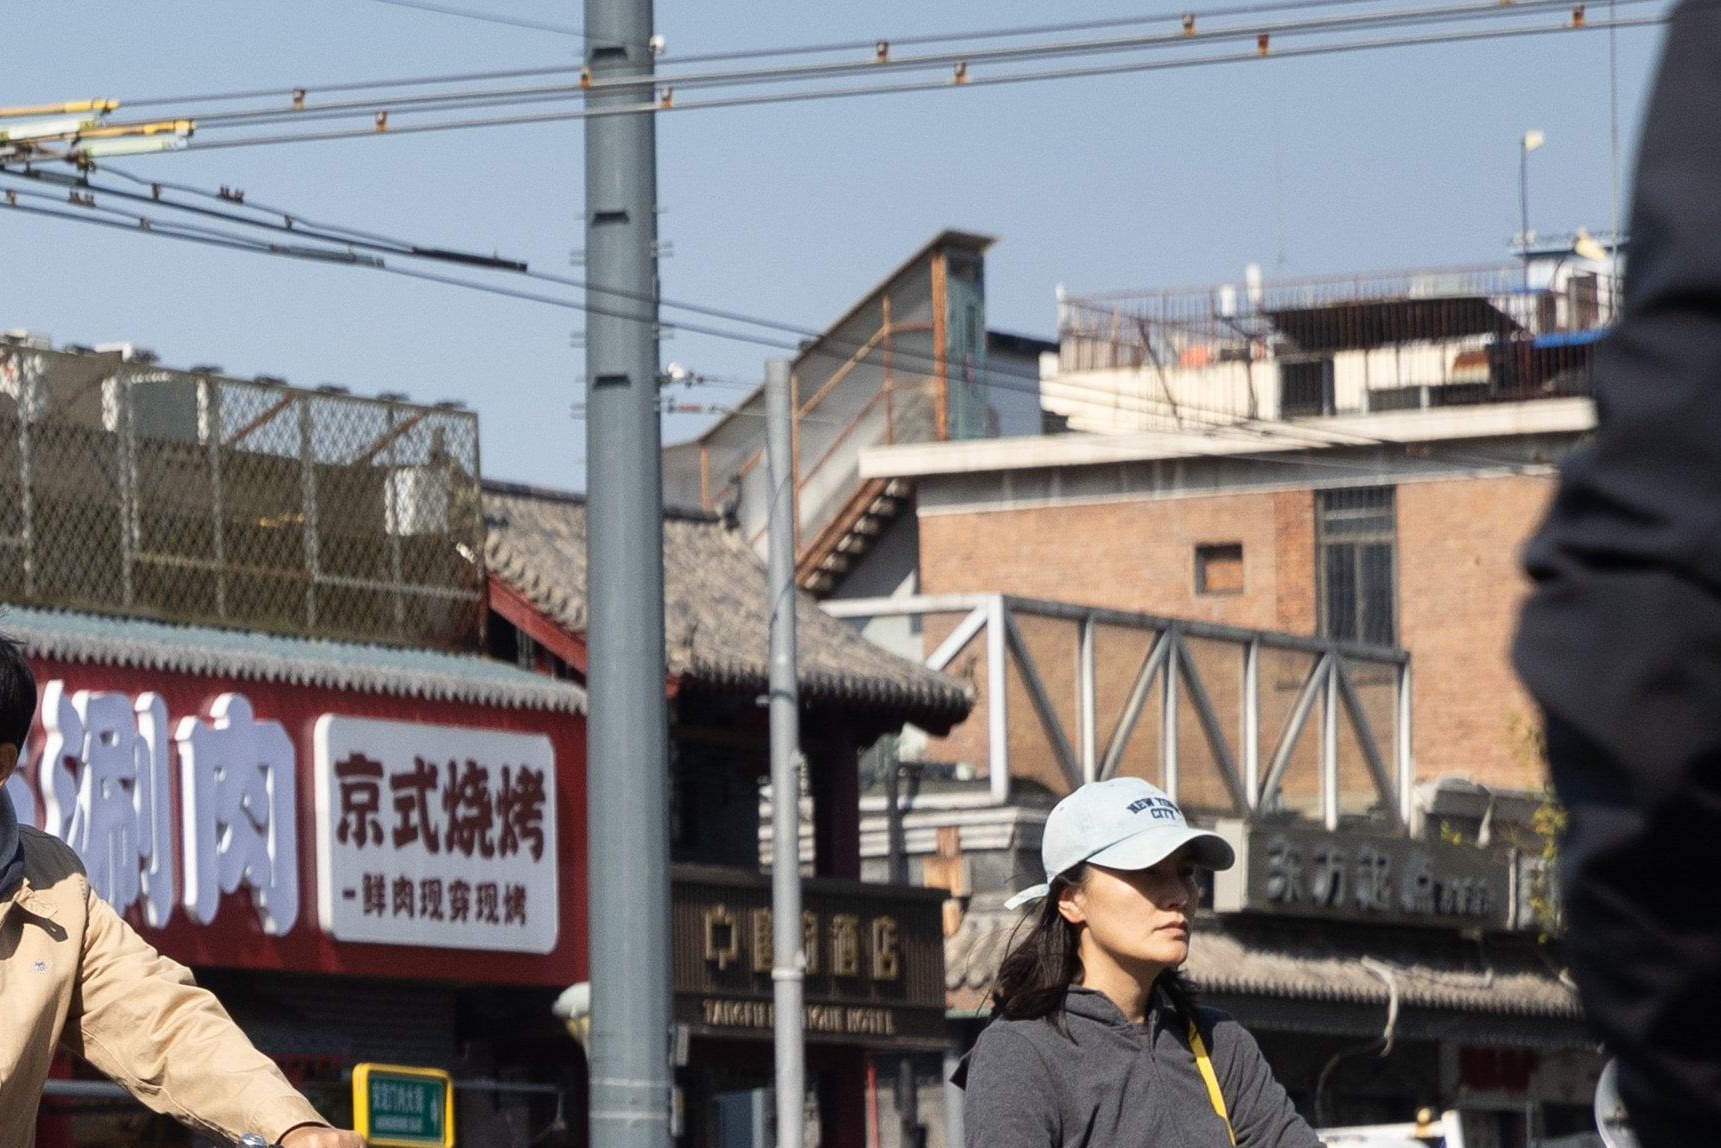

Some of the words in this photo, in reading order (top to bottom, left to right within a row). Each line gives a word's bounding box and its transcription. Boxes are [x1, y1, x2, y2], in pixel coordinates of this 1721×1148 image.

[334, 752, 547, 864] 京式烧烤
[1126, 797, 1154, 814] NEW
[1150, 807, 1176, 820] CITY
